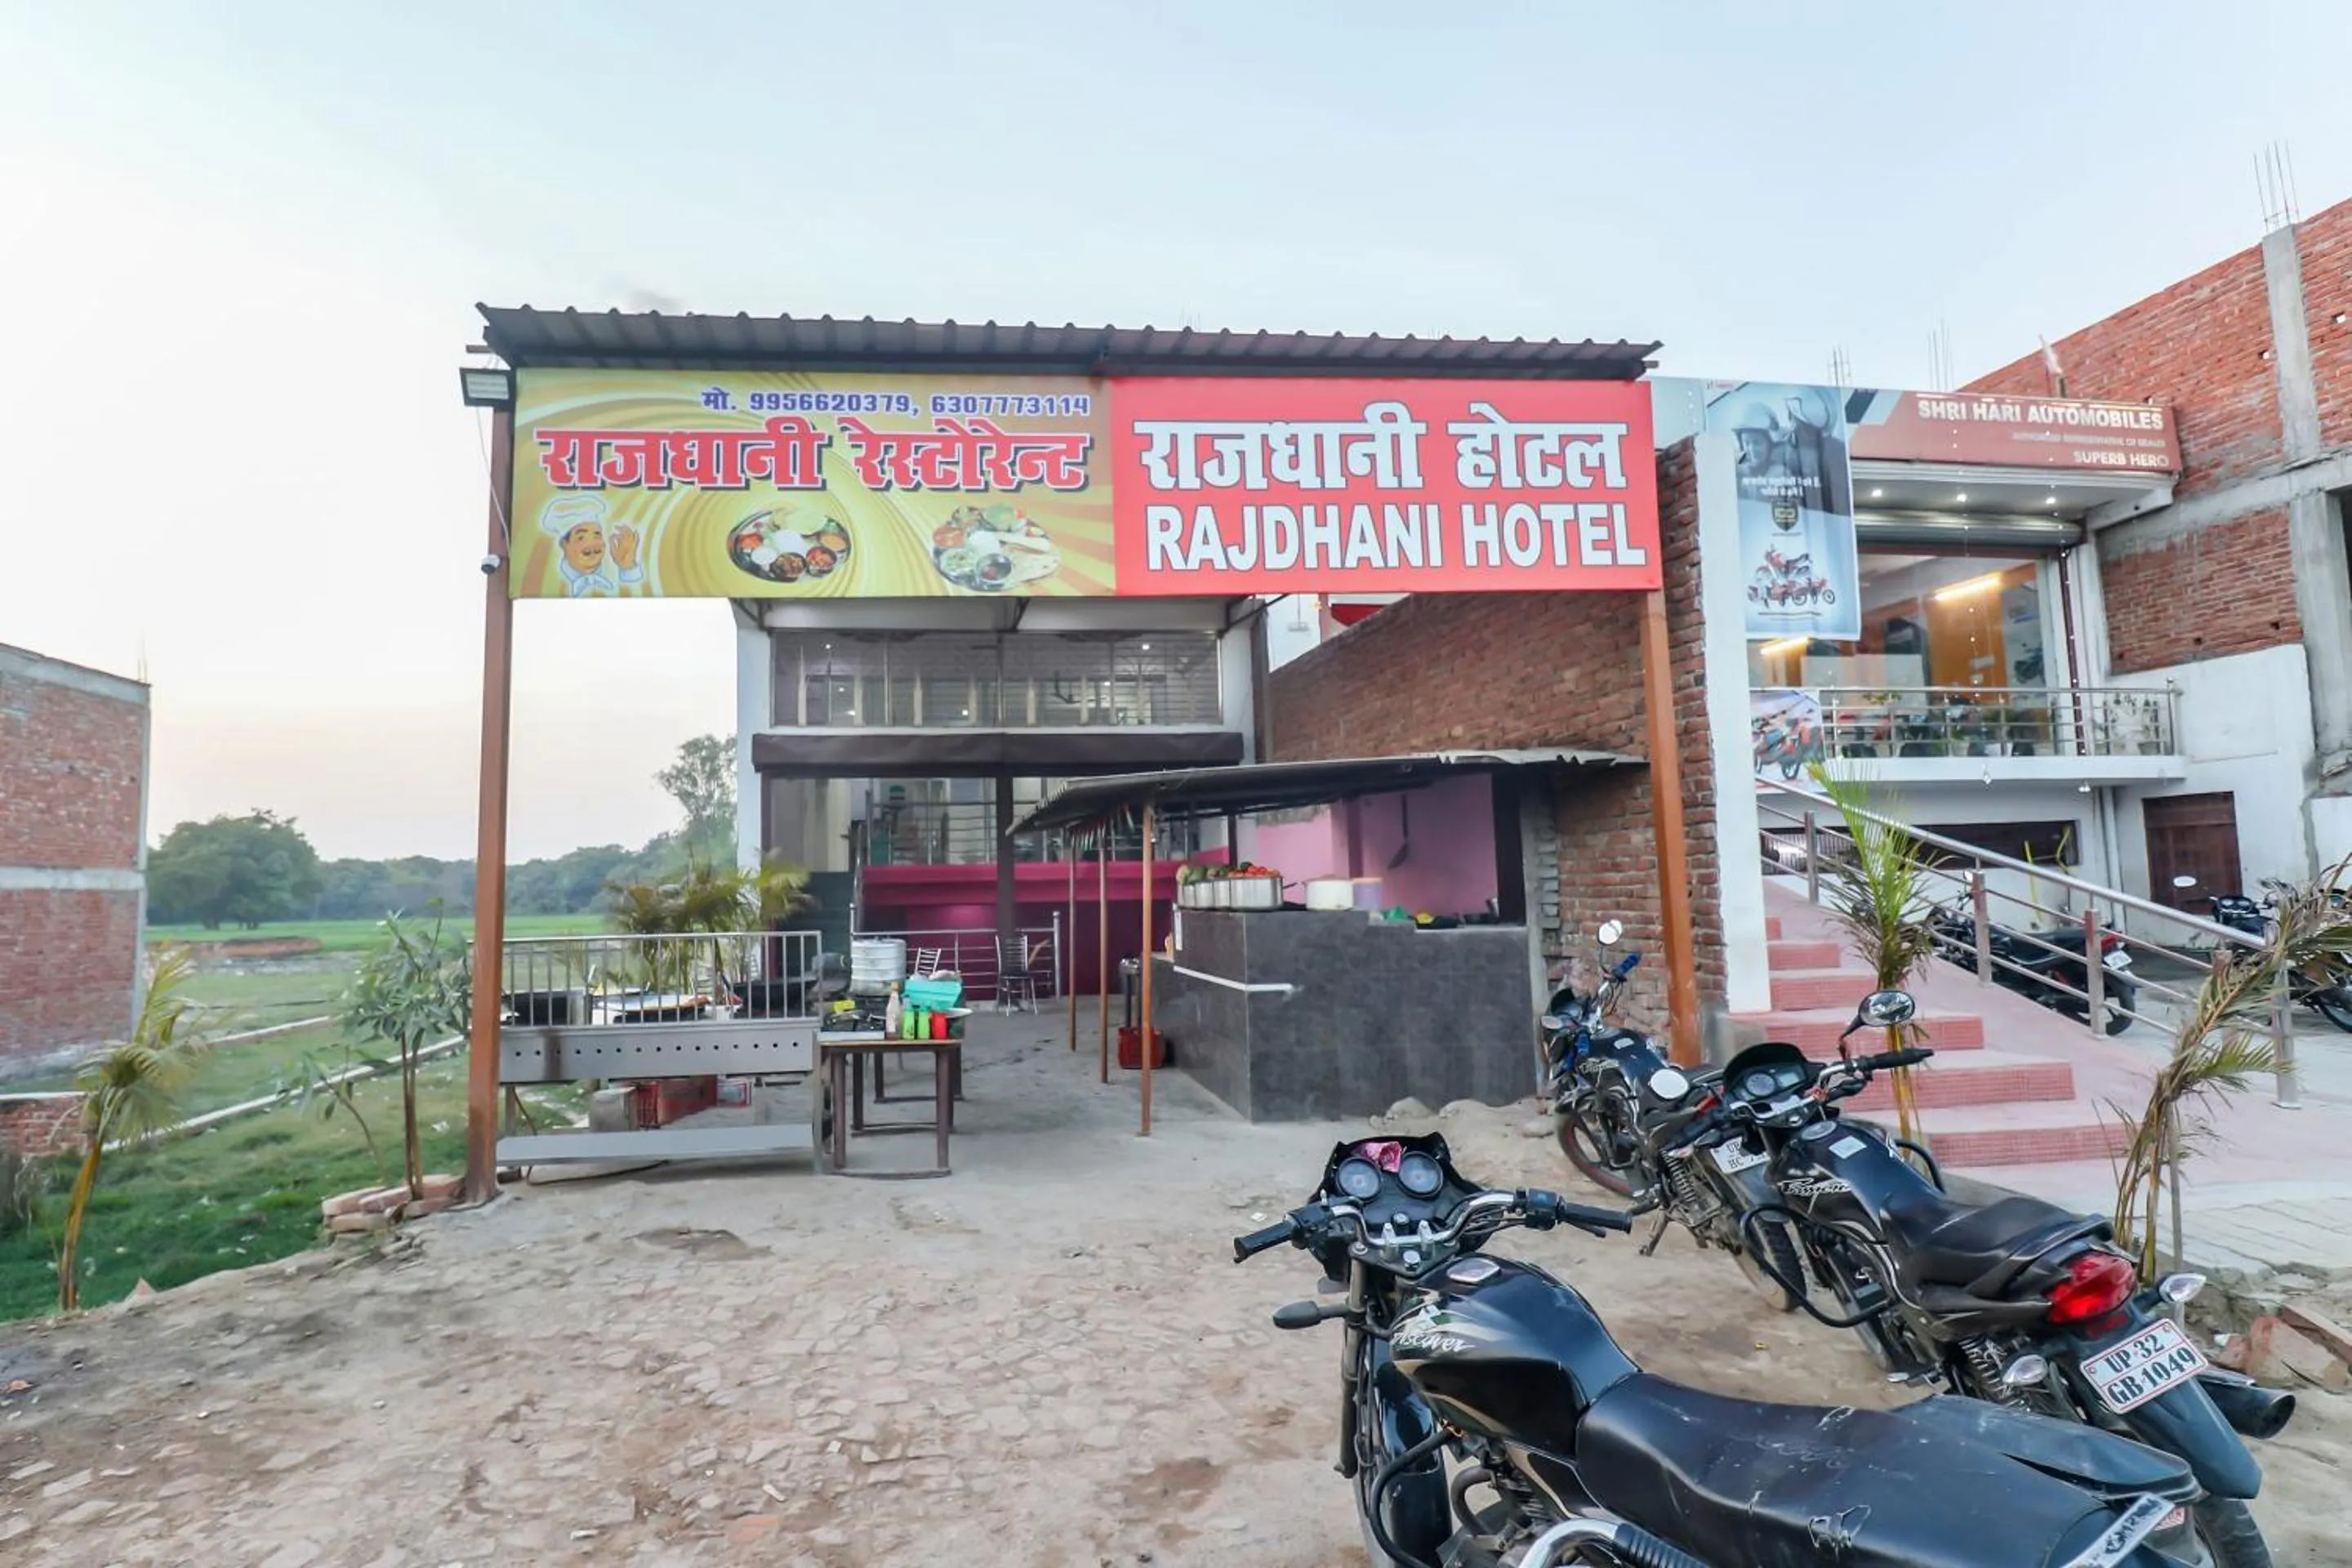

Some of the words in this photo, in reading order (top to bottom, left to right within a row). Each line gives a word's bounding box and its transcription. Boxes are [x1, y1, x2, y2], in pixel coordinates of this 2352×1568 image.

[750, 391, 918, 416] 9956620379,
[932, 394, 1089, 415] 6307773114
[1918, 399, 1967, 420] SHRI
[1972, 403, 2022, 422] HARI
[2027, 405, 2163, 430] AUTOMOBILES
[535, 416, 830, 490] राजधानी
[1133, 401, 1428, 490] राजधानी
[1446, 401, 1628, 489] होटल
[2073, 451, 2127, 466] SUPERB
[2129, 452, 2169, 469] HERO
[1146, 504, 1443, 571] RAJDHANI
[1460, 502, 1646, 568] HOTEL
